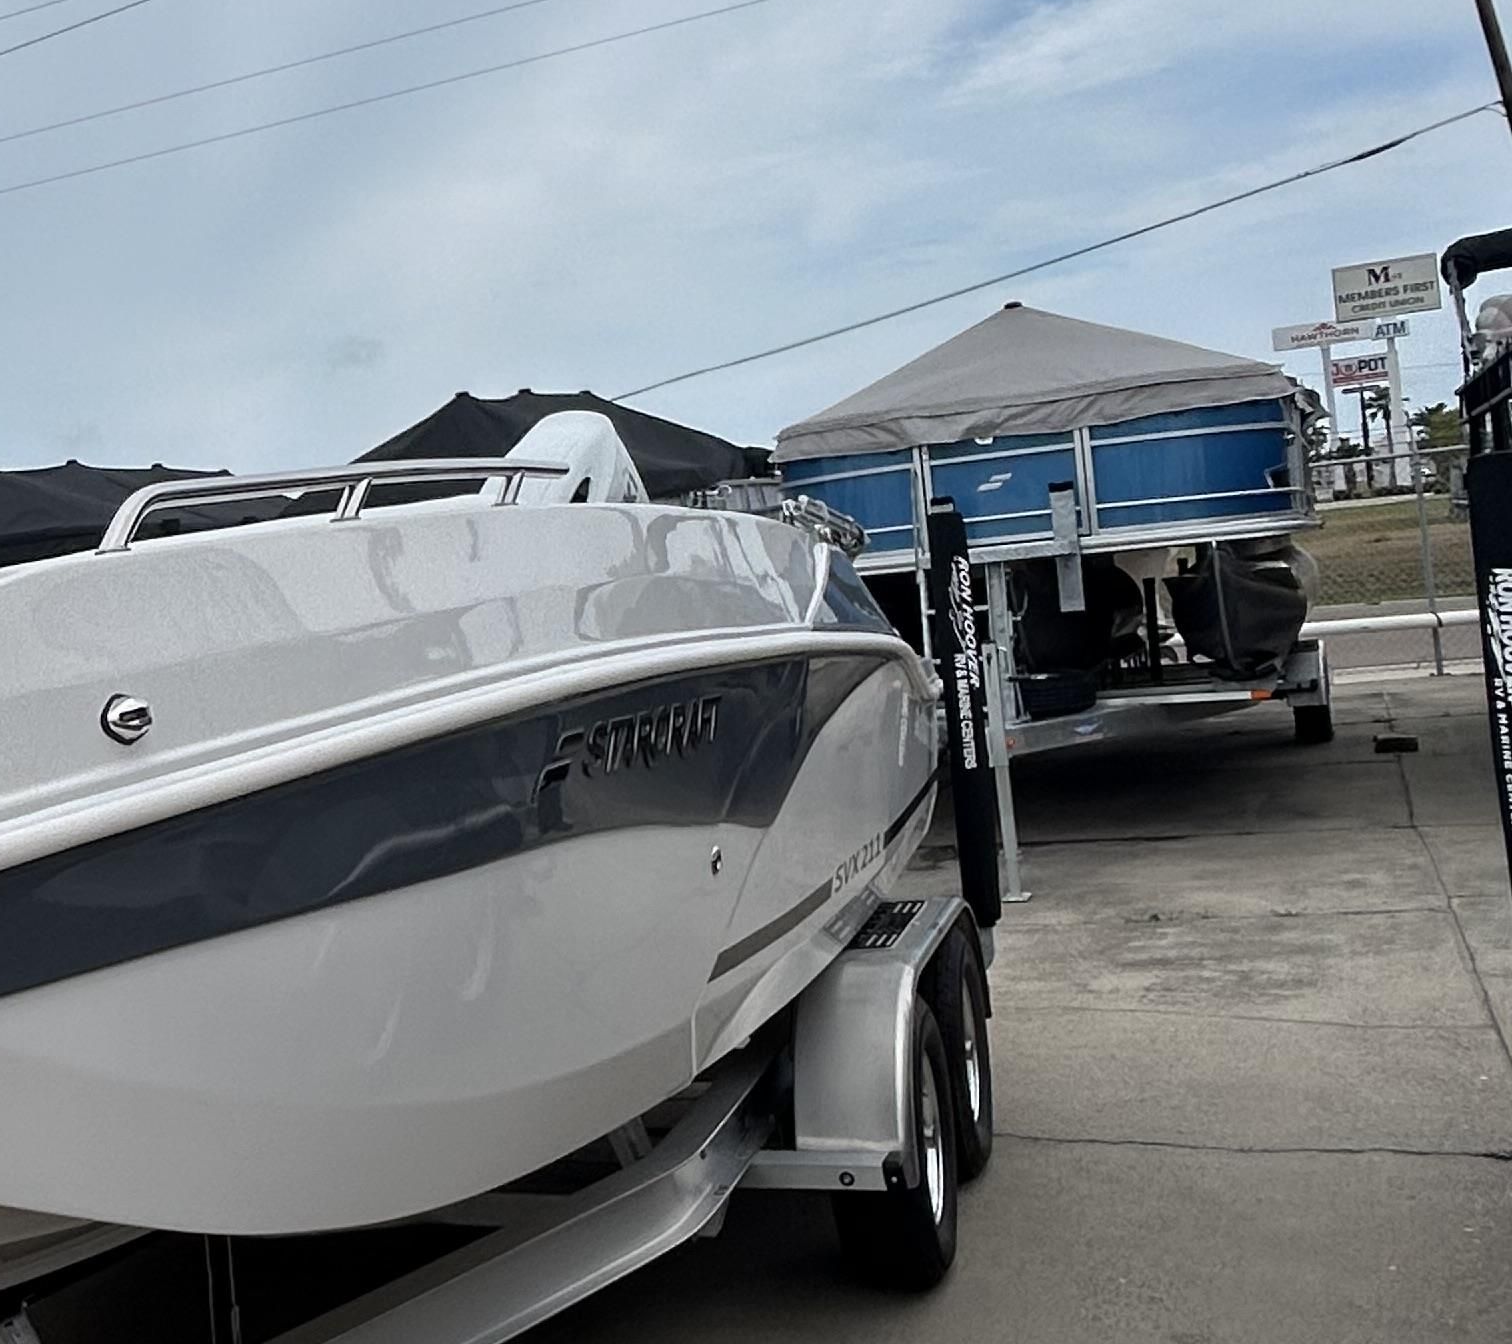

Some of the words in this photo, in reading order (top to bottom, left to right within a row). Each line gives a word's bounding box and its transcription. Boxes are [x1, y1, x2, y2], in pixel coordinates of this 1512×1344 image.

[1338, 286, 1400, 305] MEMBERS
[1402, 280, 1435, 294] FIRST
[1351, 301, 1387, 314] CREDIT
[1388, 295, 1425, 308] UNION
[1291, 326, 1360, 343] HAWTHORN
[1375, 320, 1406, 338] ATM
[953, 555, 973, 603] RON
[962, 603, 980, 688] HOOVER
[582, 693, 723, 778] STARCRAFT
[834, 852, 860, 894] SVX
[860, 831, 882, 869] 211
